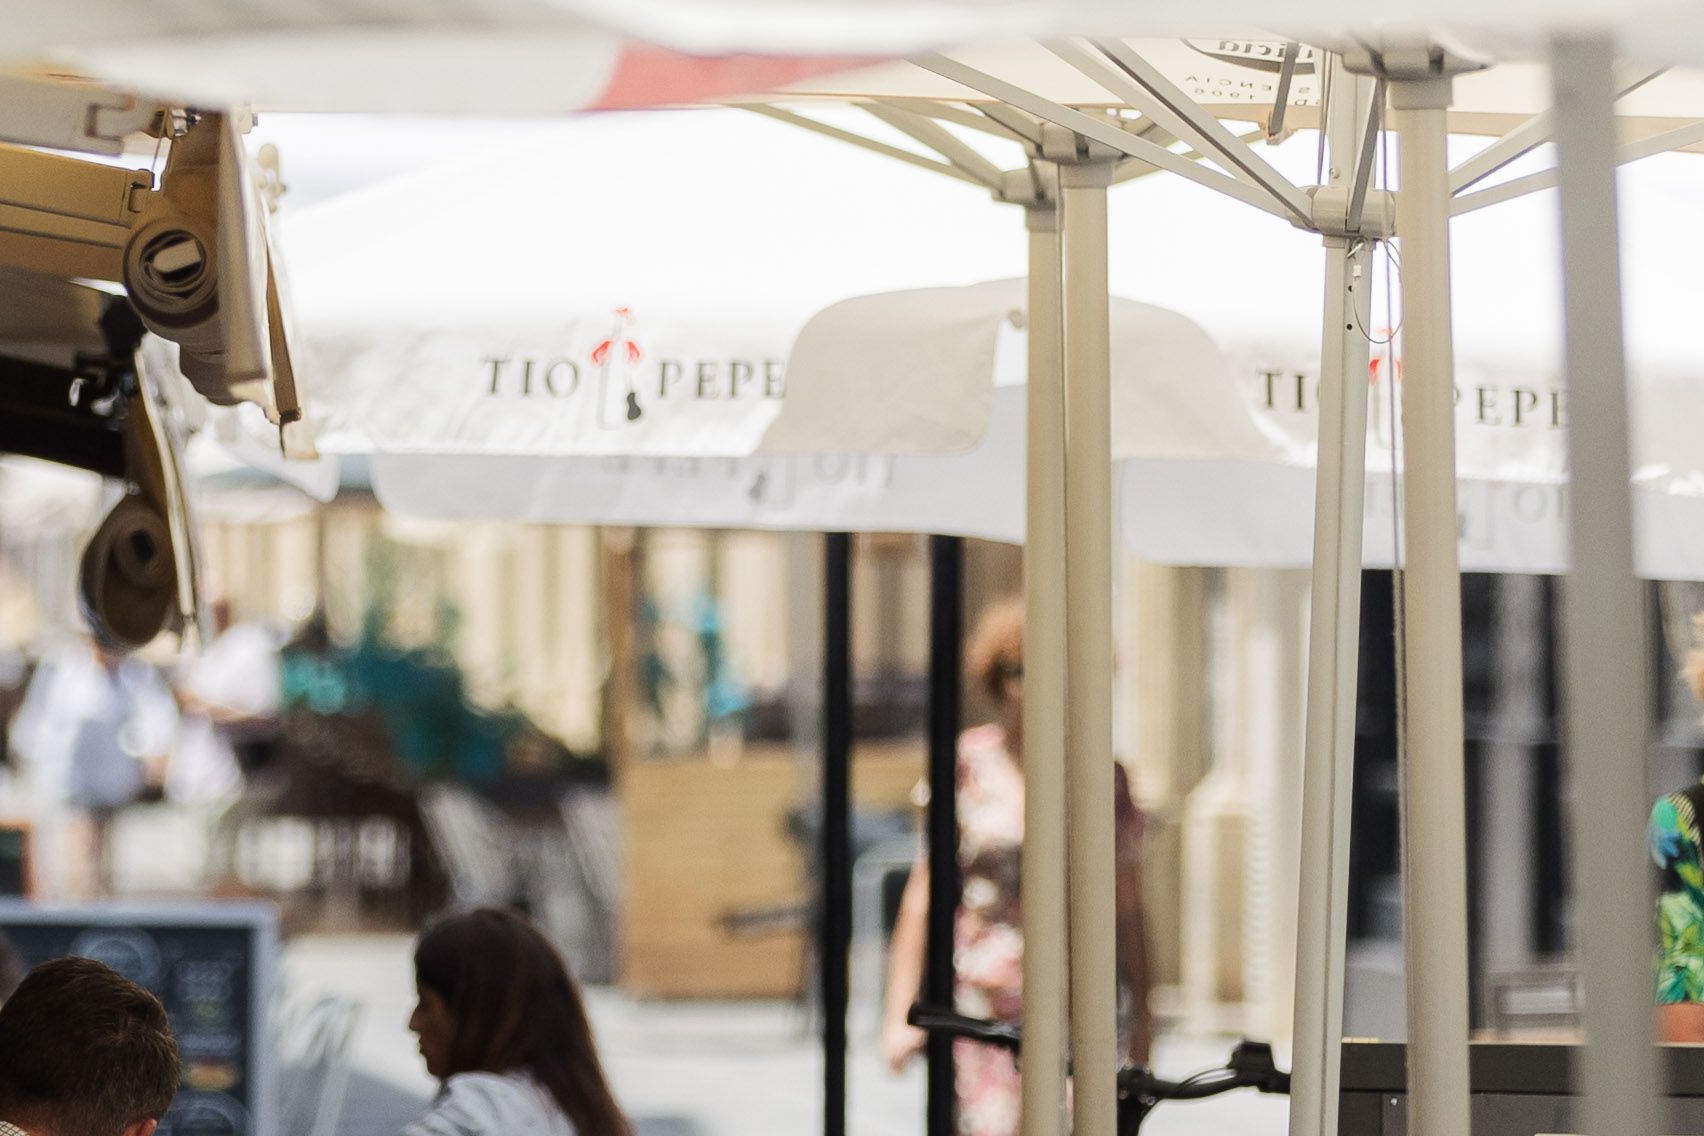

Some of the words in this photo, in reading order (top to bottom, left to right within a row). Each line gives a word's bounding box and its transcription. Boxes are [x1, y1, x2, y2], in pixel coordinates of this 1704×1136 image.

[483, 359, 580, 398] TIO
[657, 359, 786, 399] PEPE
[1256, 368, 1321, 413] TI
[1453, 385, 1568, 429] EPE
